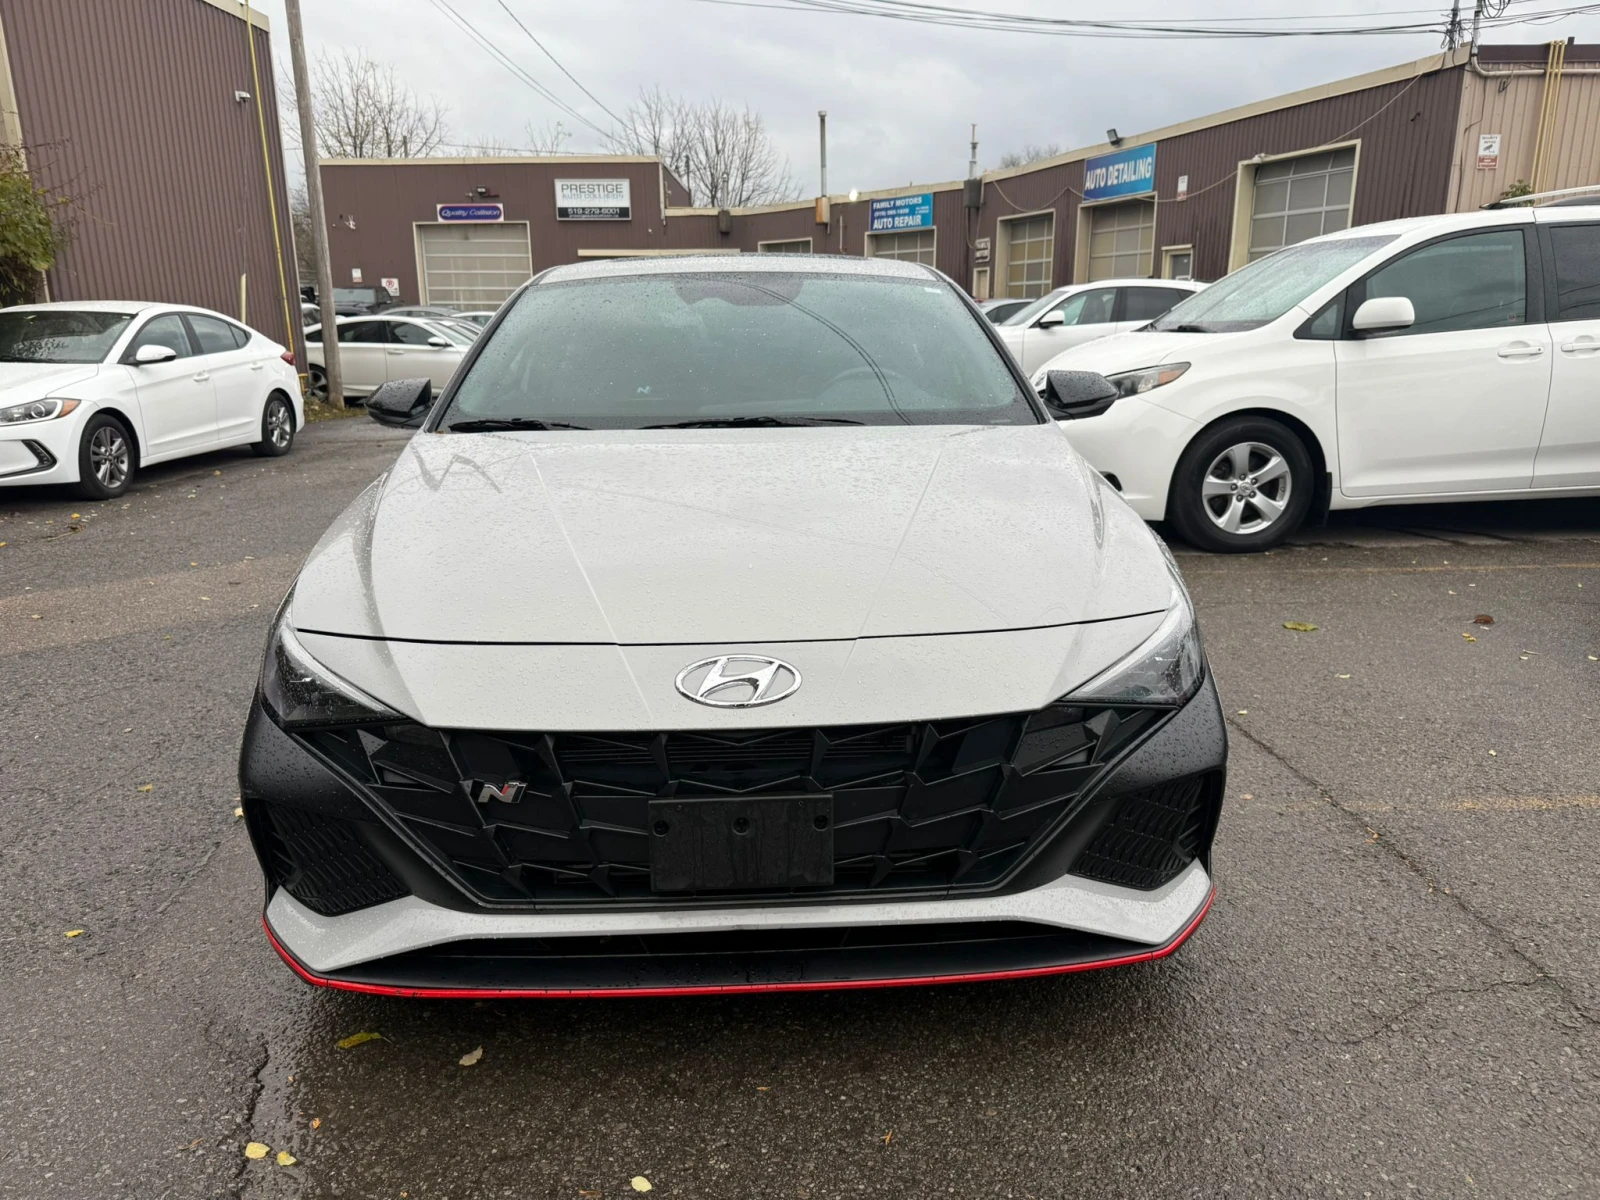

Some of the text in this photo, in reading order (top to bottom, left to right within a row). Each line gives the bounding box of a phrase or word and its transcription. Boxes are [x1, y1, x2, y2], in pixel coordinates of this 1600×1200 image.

[1084, 156, 1153, 191] AUTO DETAILING
[561, 183, 623, 194] PRESTIGE
[873, 196, 922, 210] FAMILY MOTORS
[441, 208, 500, 217] Quality Collision
[872, 214, 922, 230] AUTO REPAIR
